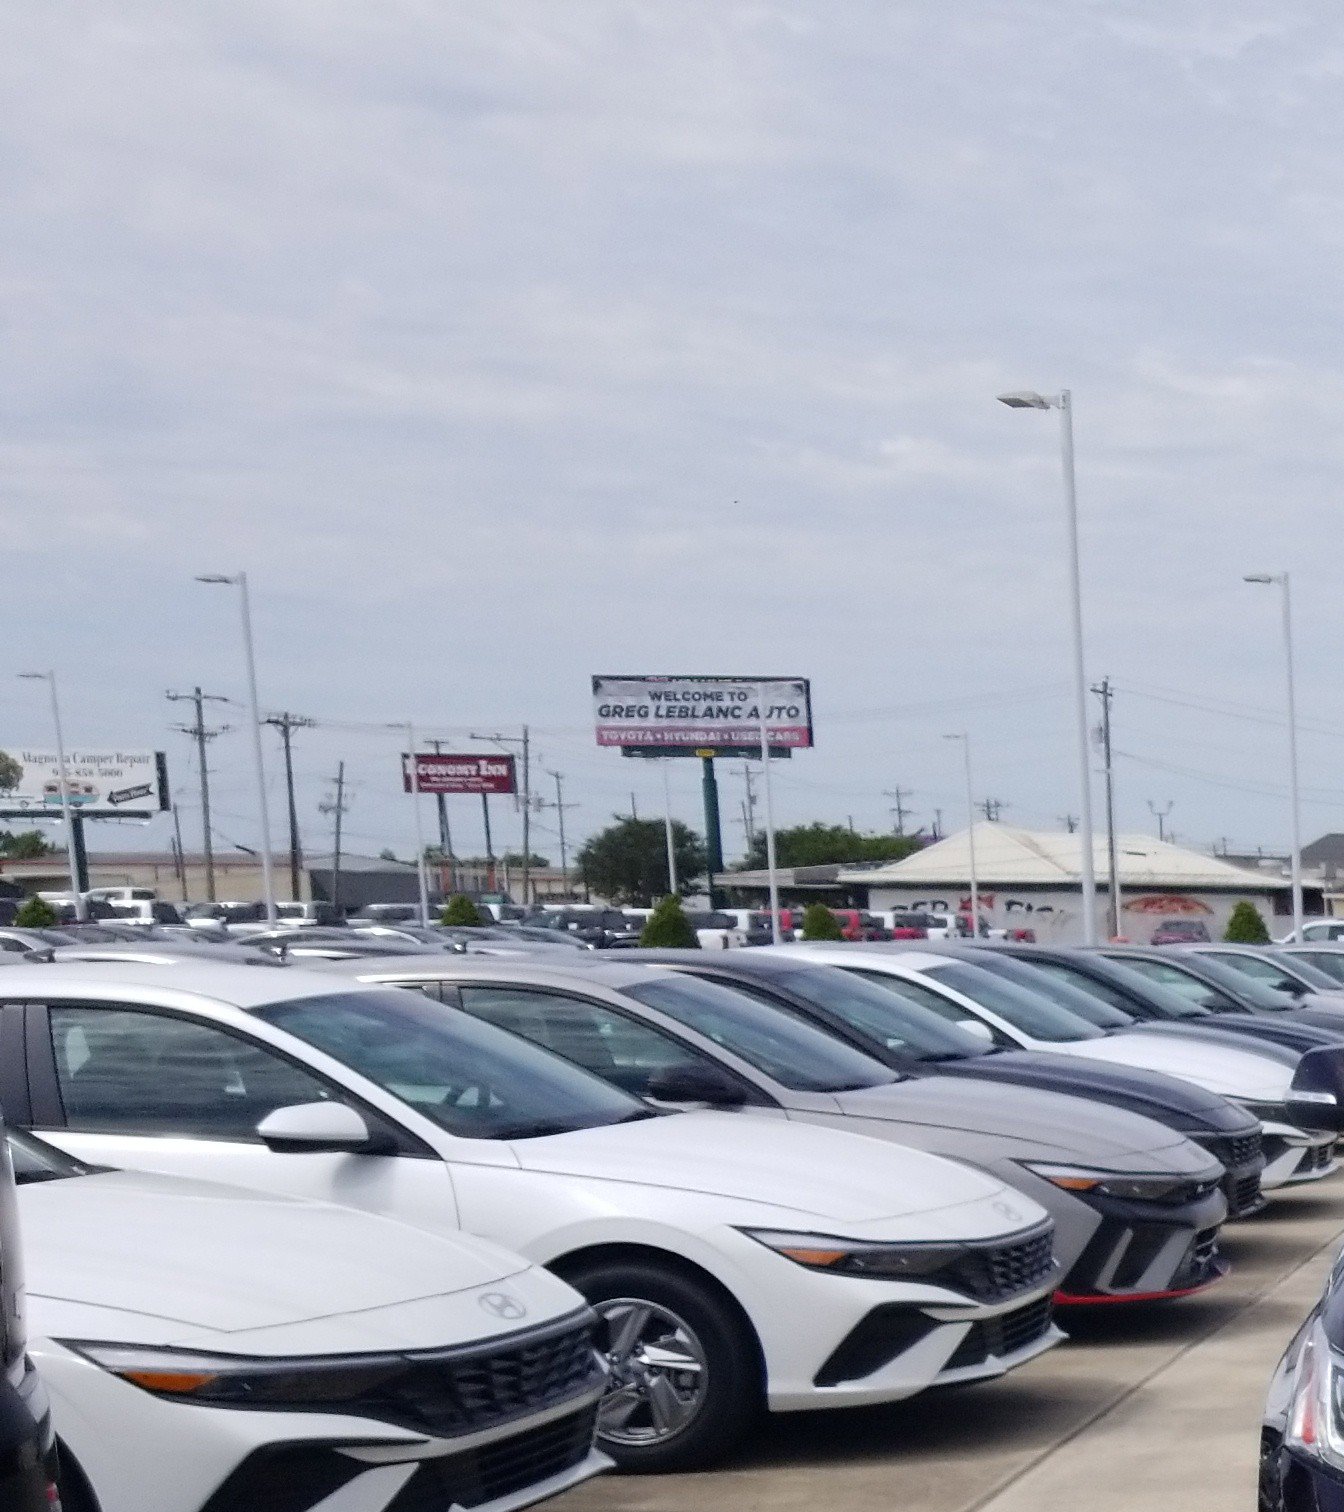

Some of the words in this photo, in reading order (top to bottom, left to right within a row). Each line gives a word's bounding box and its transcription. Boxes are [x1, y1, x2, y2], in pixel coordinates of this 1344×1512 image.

[649, 690, 724, 702] WELCOME
[729, 691, 748, 702] TO
[598, 704, 649, 719] GREG
[654, 704, 742, 720] LEBLANC
[601, 730, 654, 742] TOYOTA
[664, 730, 722, 742] HYUNDAI
